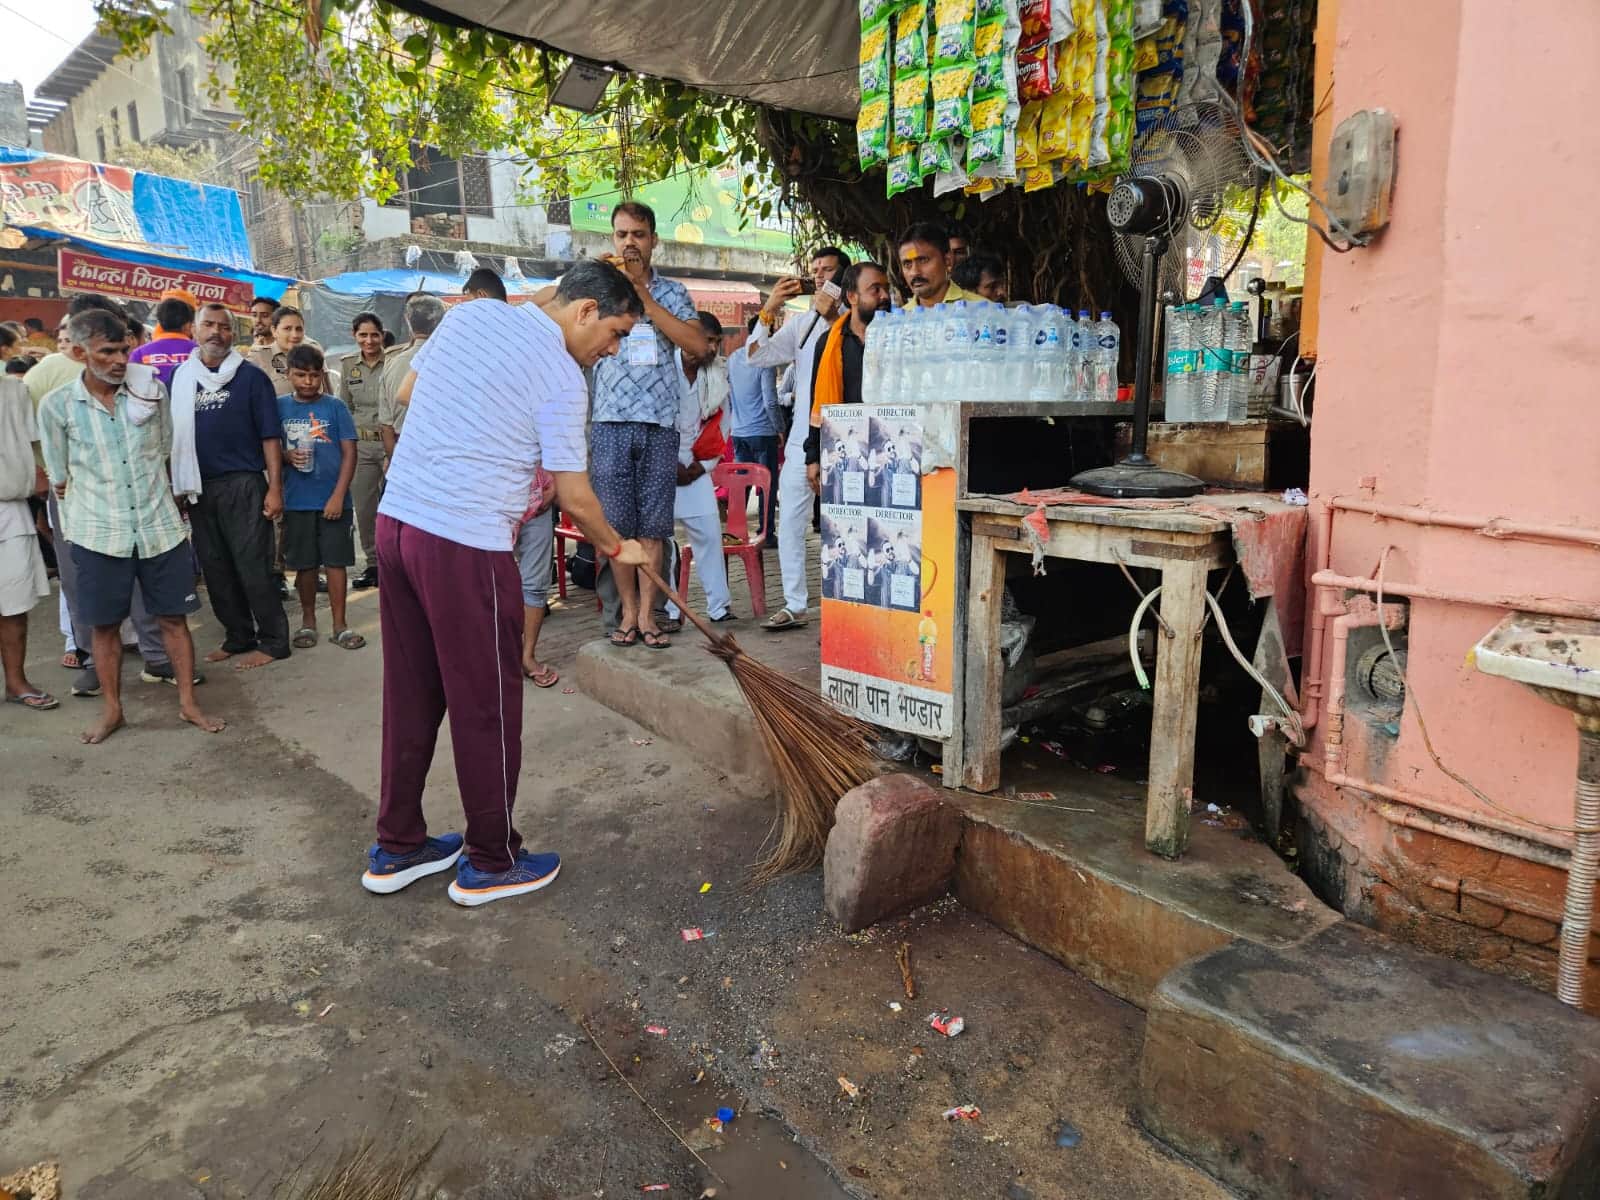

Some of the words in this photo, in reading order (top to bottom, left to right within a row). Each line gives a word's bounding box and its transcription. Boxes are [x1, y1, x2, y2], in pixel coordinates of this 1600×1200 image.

[72, 263, 127, 285] कान्हा
[131, 267, 186, 291] मिठाई
[186, 281, 228, 300] वाला
[827, 408, 863, 417] DIRECTOR
[877, 408, 916, 417] DIRECTOR
[828, 506, 862, 516] DIRECTOR
[875, 509, 914, 521] DIRECTOR
[828, 676, 859, 709] लाला
[866, 685, 890, 717] पान
[897, 693, 943, 731] भण्डार
